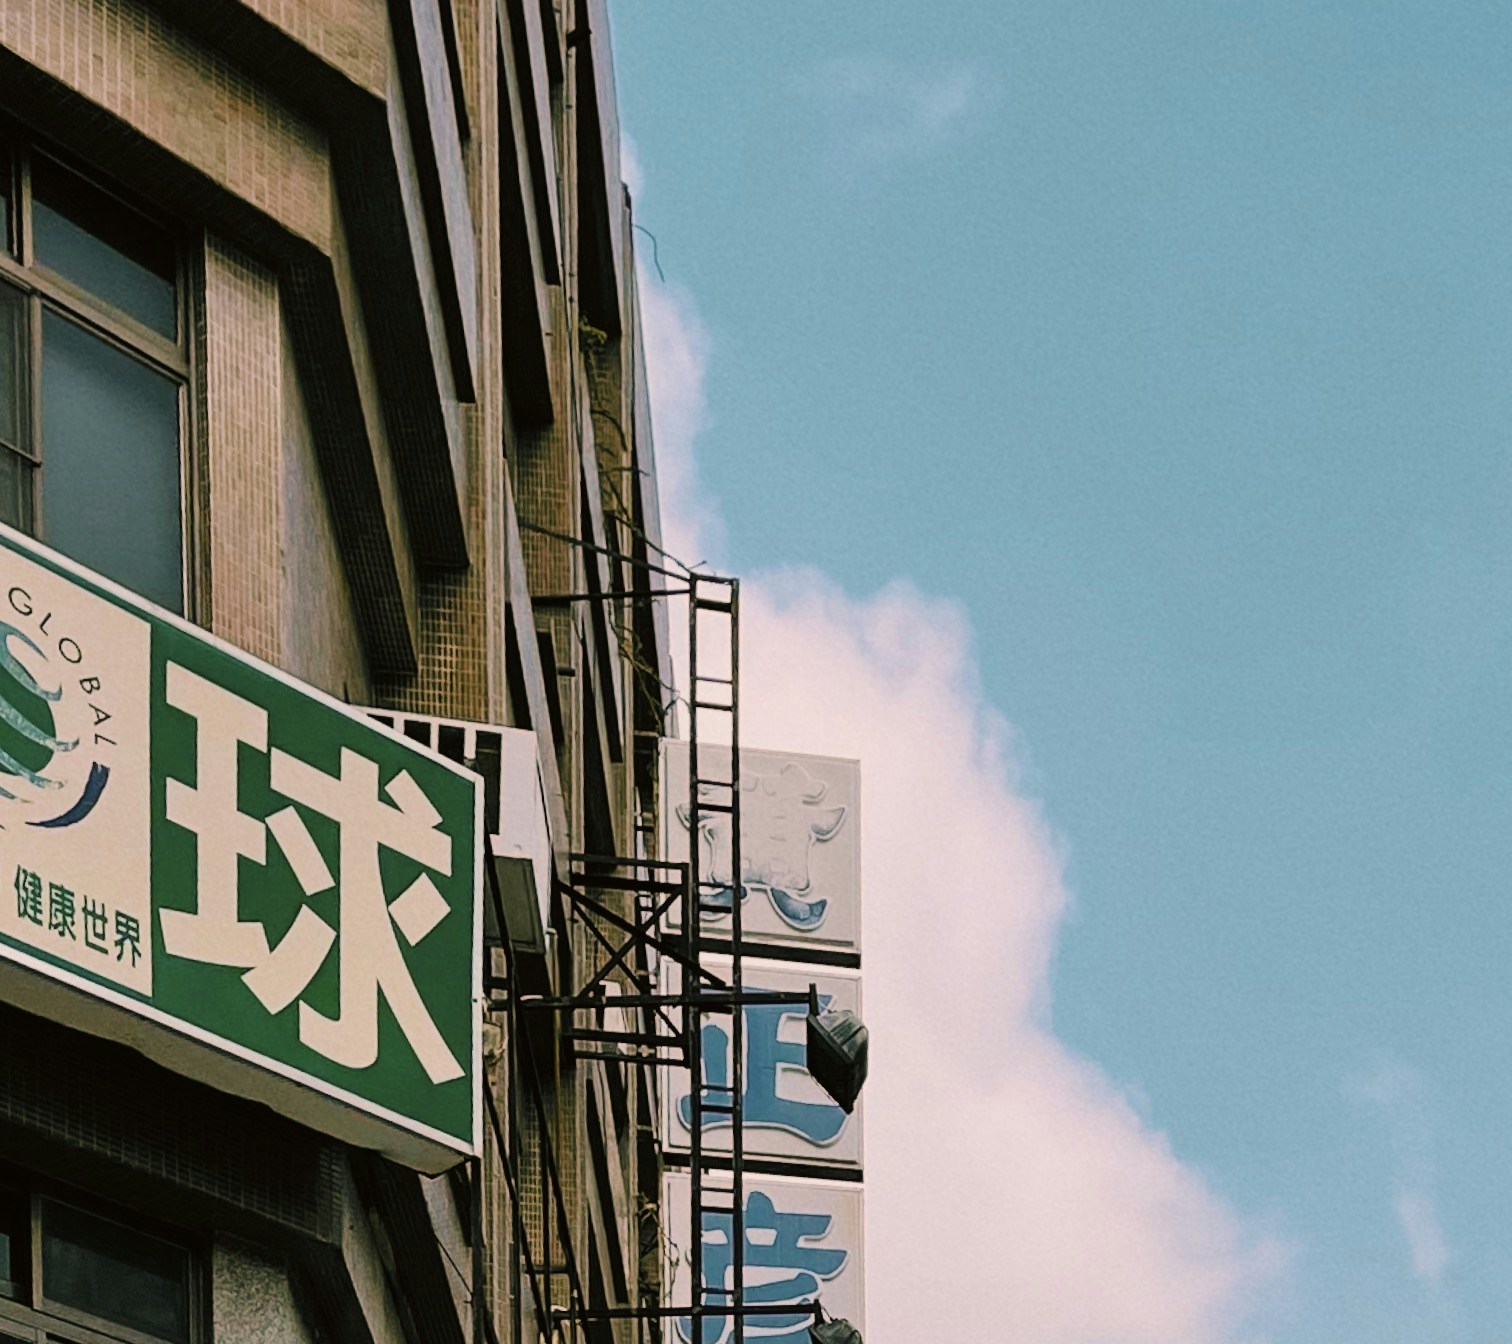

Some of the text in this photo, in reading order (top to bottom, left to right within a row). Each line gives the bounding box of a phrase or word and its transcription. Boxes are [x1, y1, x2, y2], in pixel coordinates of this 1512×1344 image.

[9, 586, 117, 748] GLOBAL
[14, 865, 143, 968] 健康世界
[160, 659, 466, 1084] 球
